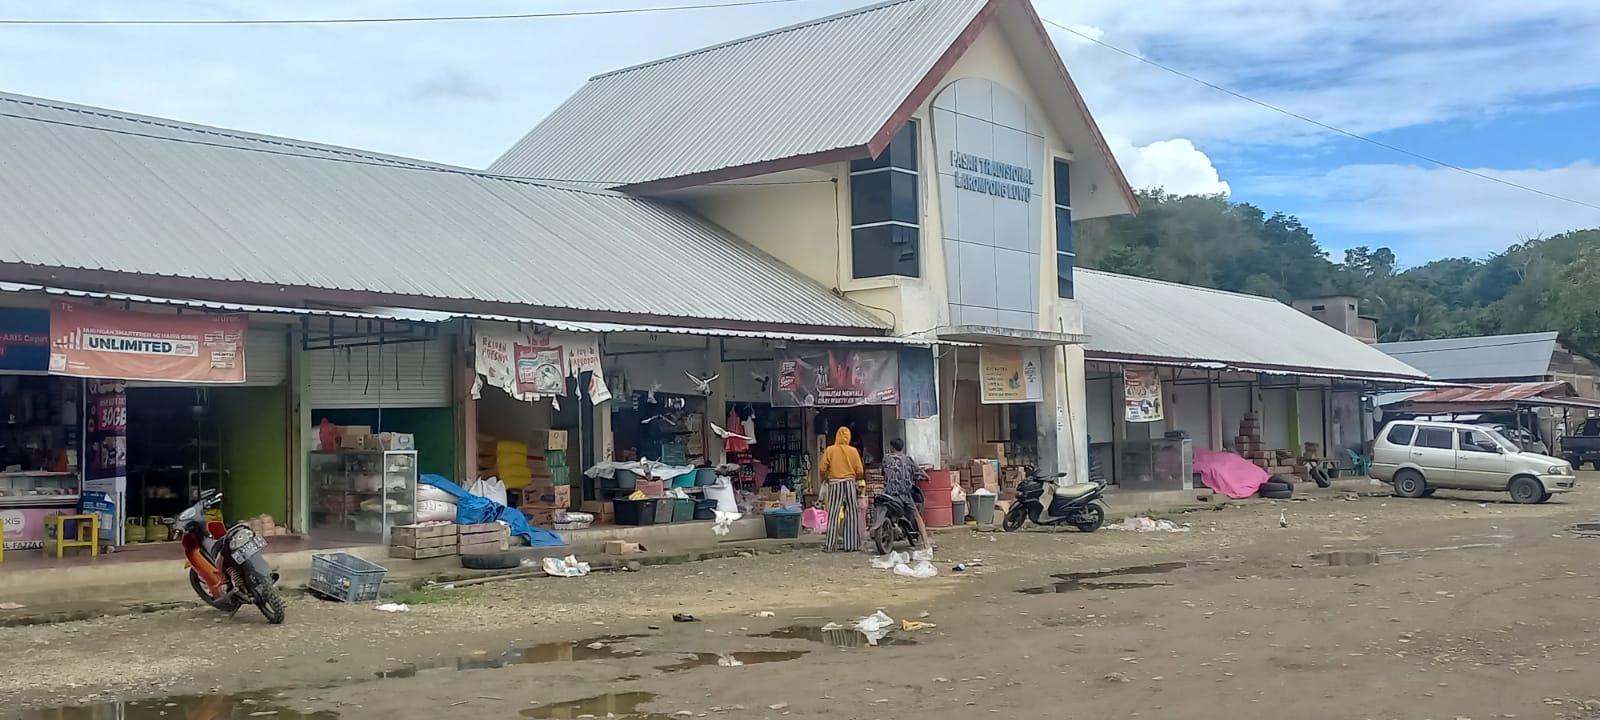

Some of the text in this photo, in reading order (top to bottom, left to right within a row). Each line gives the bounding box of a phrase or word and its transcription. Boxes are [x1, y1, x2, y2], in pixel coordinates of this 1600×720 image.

[950, 150, 1034, 184] PASAR TRADISIONAL
[954, 171, 1031, 204] LAROMPONG LUWU
[88, 337, 173, 353] UNLIMITED
[101, 406, 126, 428] 30GB
